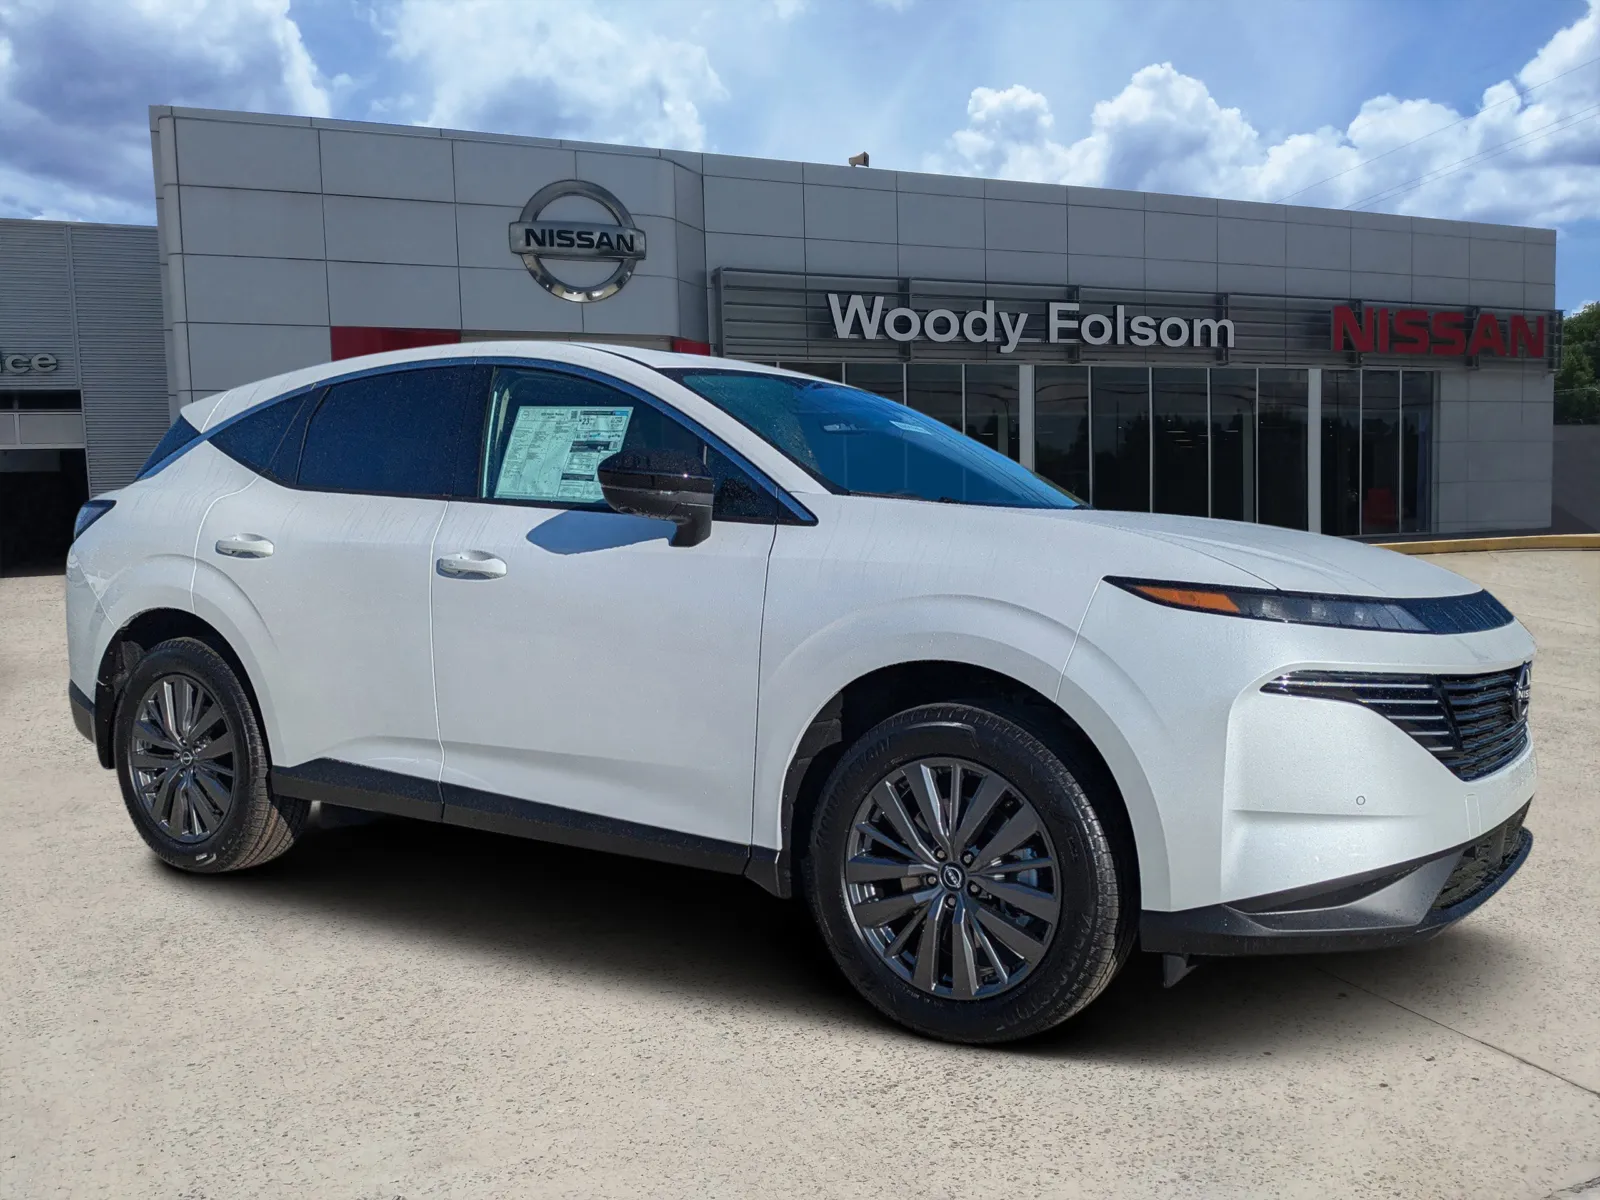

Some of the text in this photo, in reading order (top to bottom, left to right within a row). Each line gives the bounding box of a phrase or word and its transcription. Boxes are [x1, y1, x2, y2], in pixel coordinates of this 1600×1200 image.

[525, 228, 634, 252] NISSAN
[827, 293, 1236, 354] Woody Folsom
[1331, 305, 1545, 358] NISSAN
